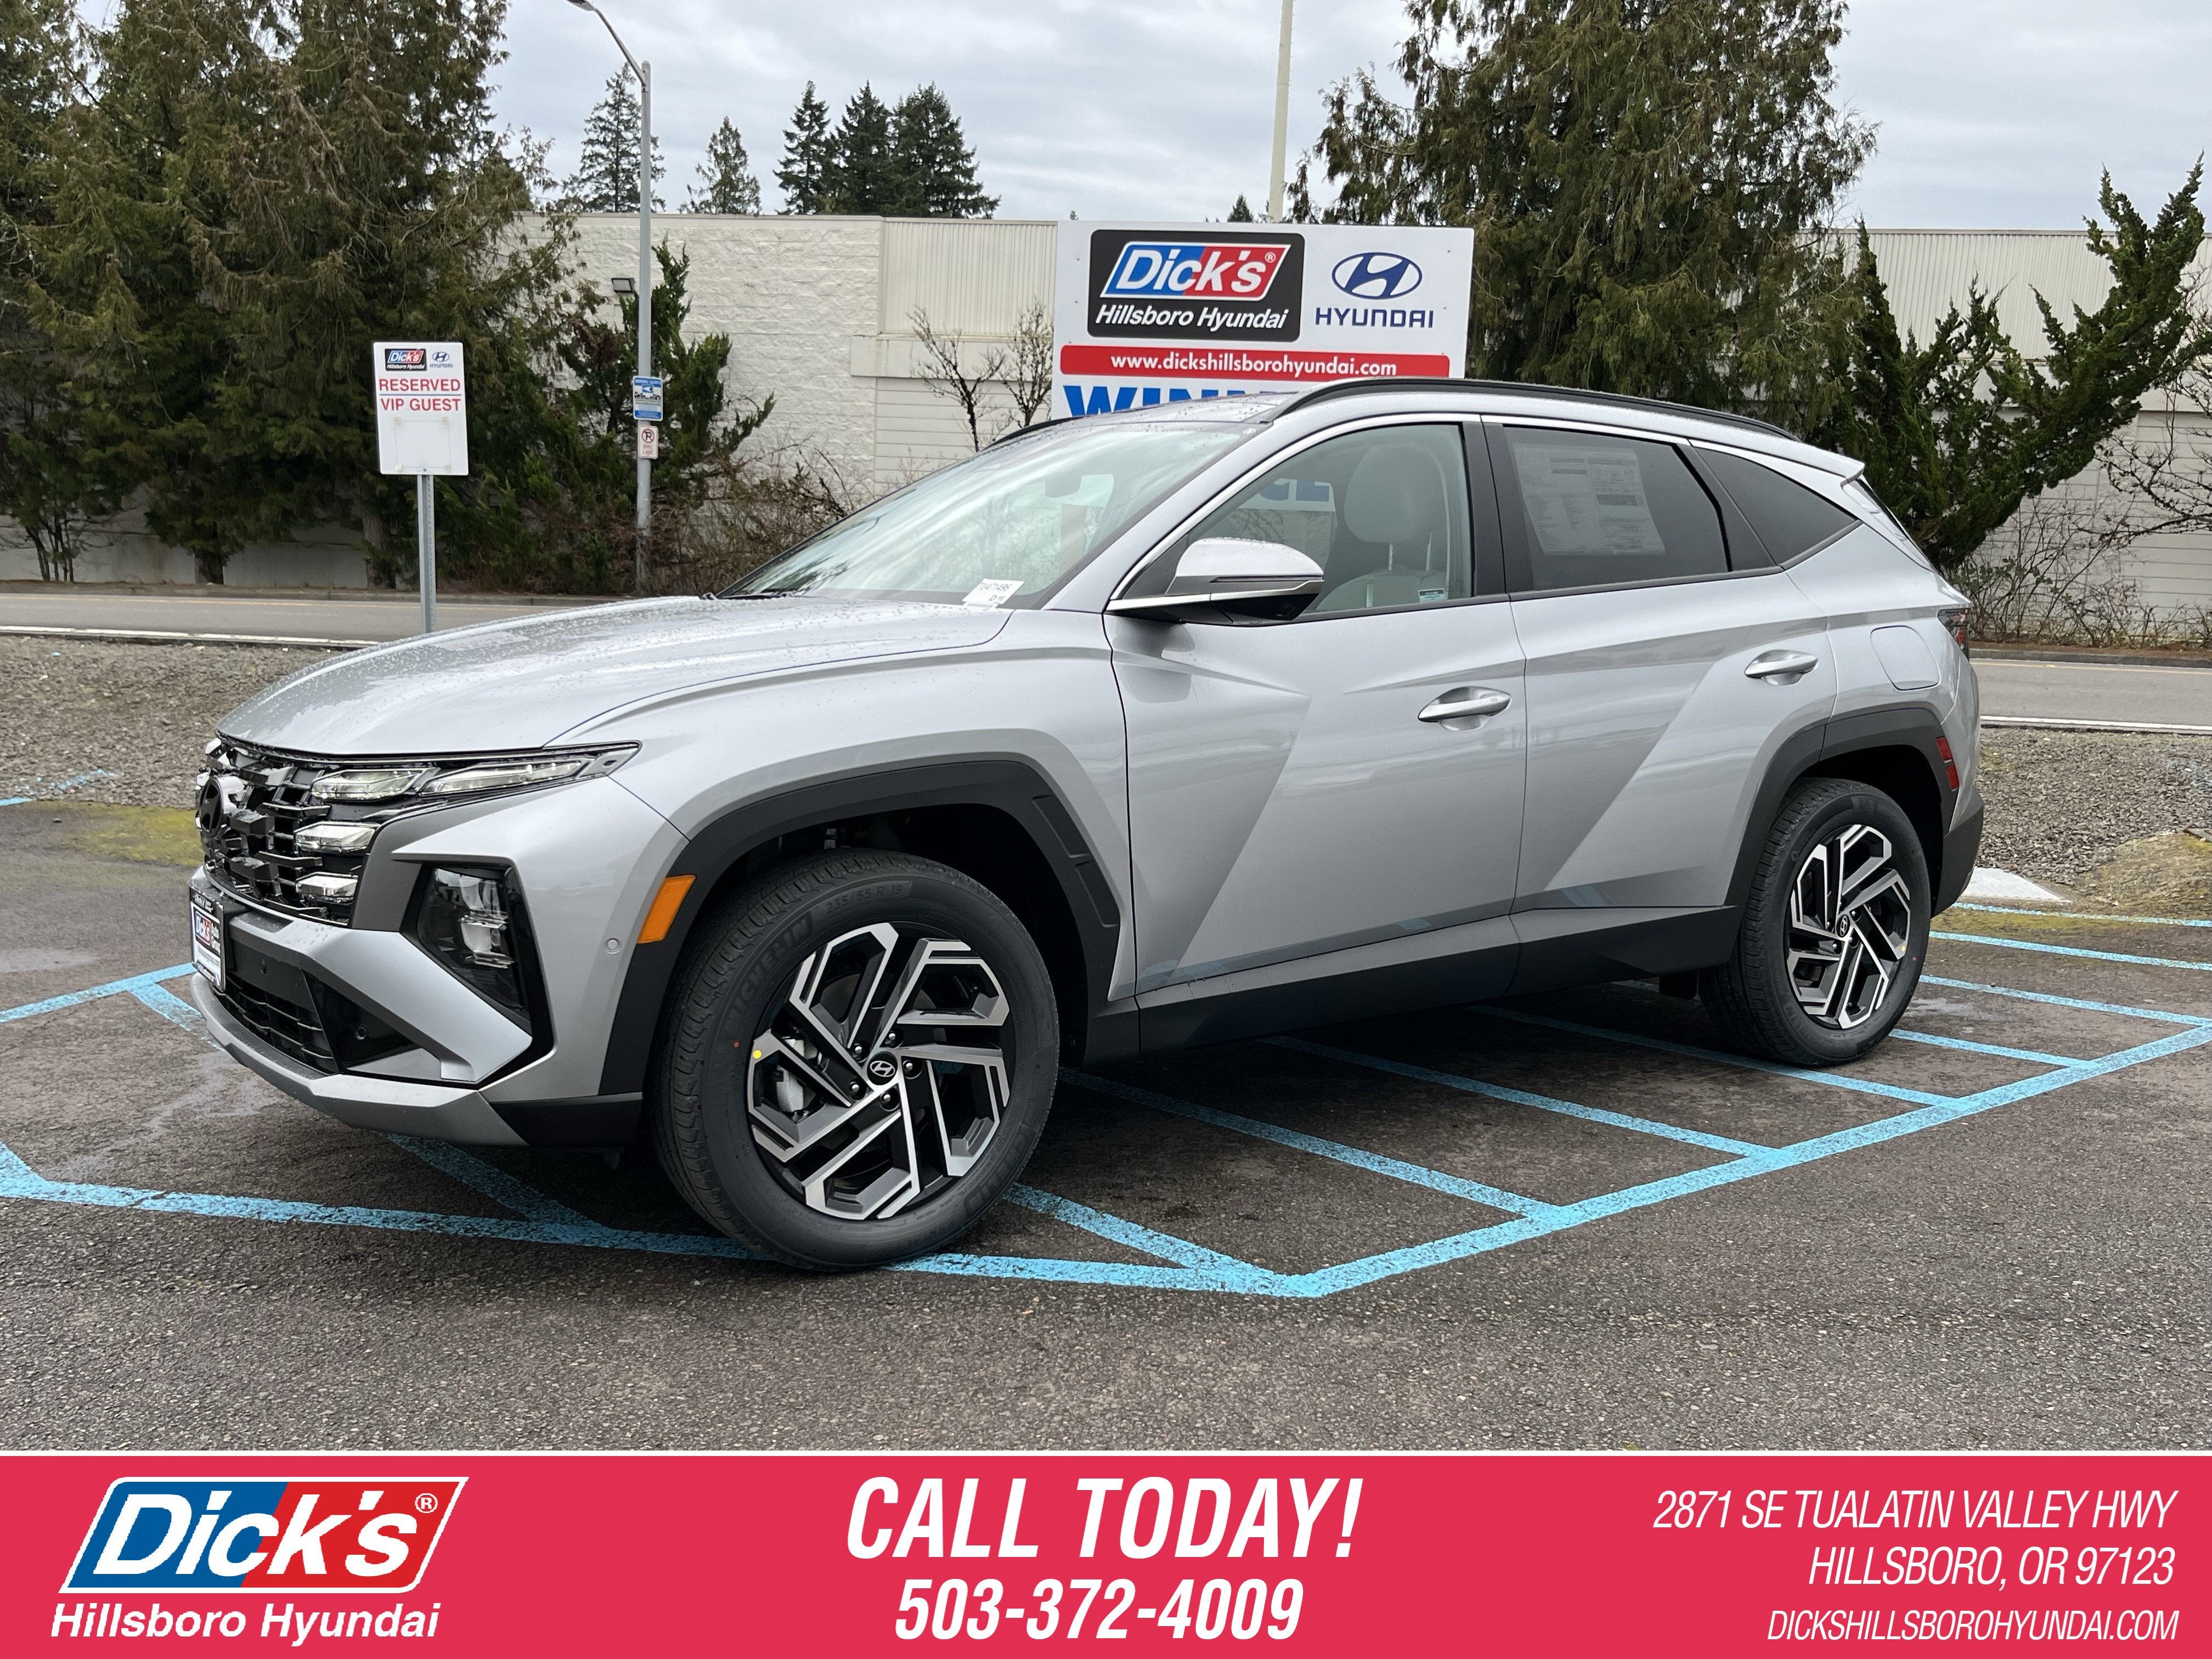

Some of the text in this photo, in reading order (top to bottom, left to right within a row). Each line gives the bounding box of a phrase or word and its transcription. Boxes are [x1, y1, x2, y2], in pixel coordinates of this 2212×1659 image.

[1115, 249, 1266, 293] Dick's
[1096, 304, 1289, 332] Hillsboro Hyundai
[1315, 307, 1434, 328] HYUNDAI
[390, 352, 421, 363] Dick's
[1110, 351, 1397, 377] www.dickshillsborohyundai.com
[379, 379, 461, 392] RESERVED
[381, 398, 461, 411] VIP GUEST
